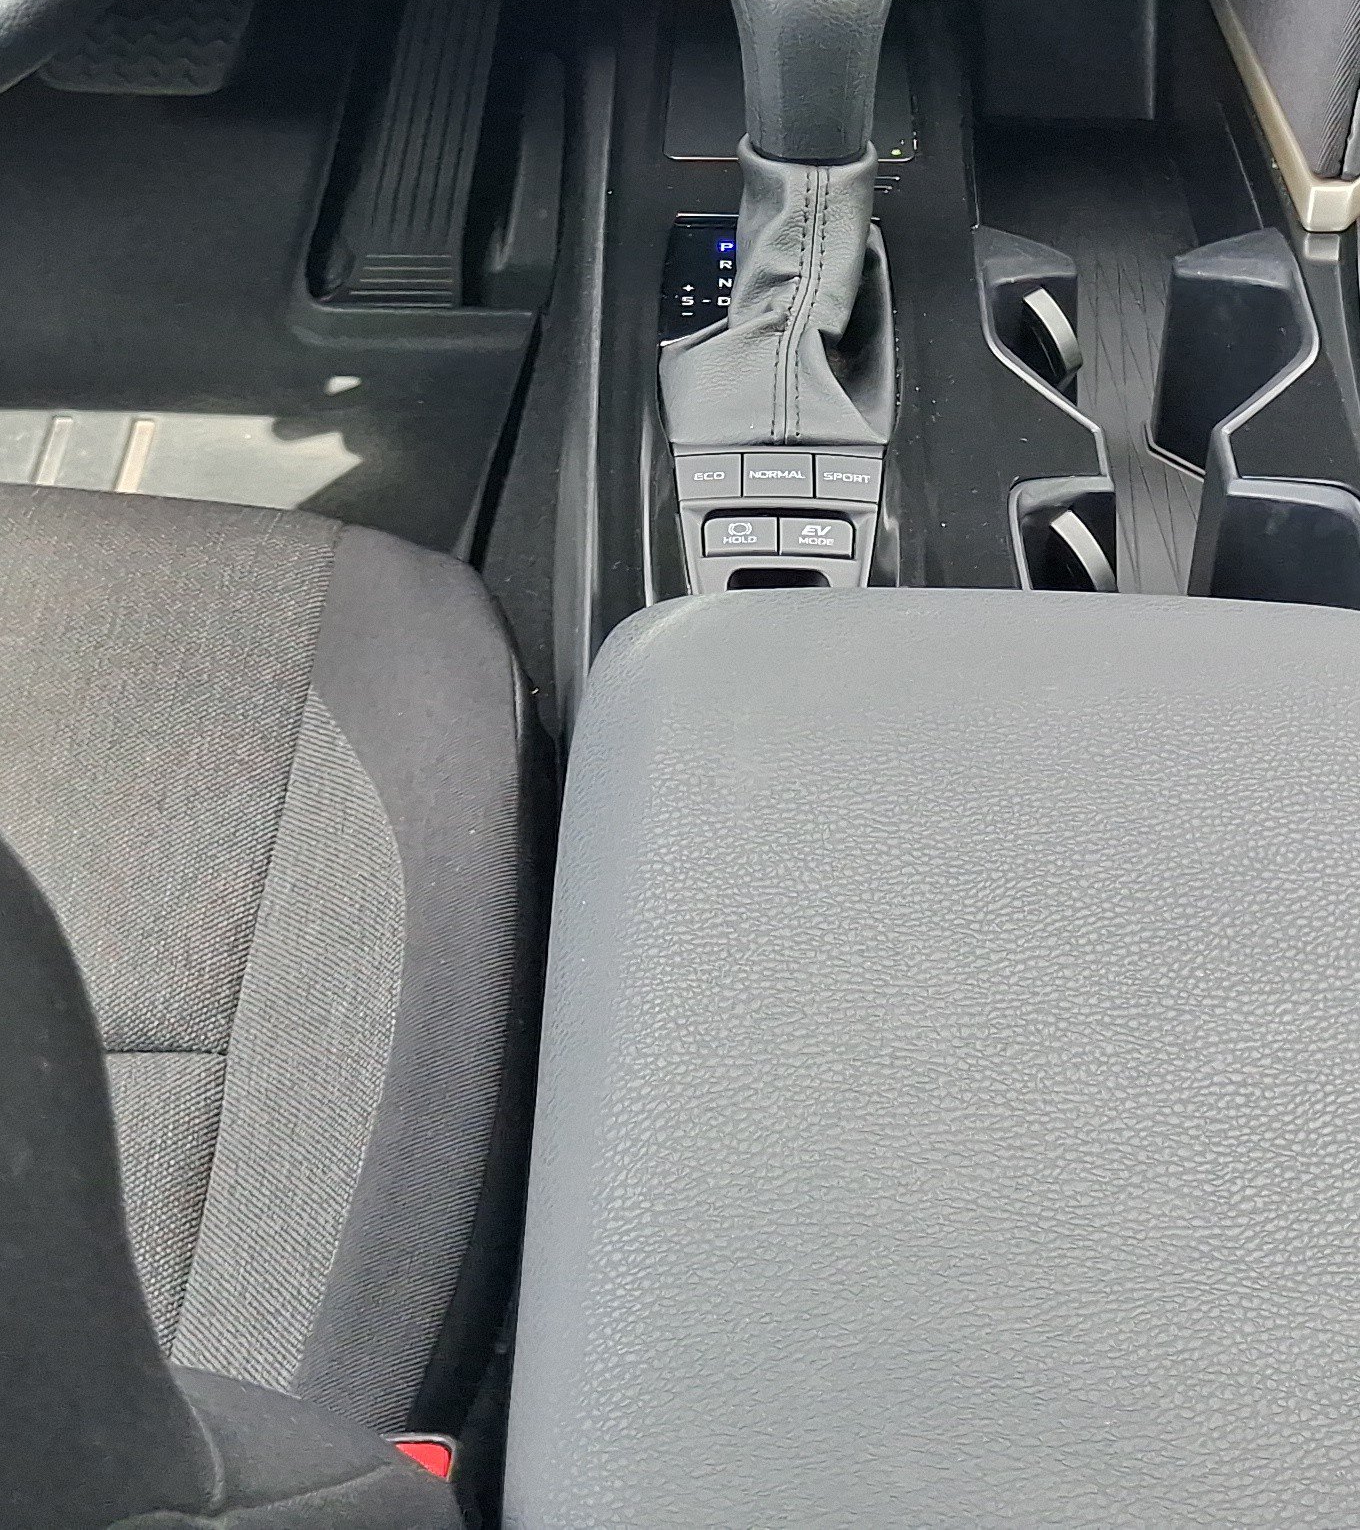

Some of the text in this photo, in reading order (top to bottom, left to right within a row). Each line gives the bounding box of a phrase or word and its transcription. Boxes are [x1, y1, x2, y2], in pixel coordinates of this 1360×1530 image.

[720, 241, 734, 253] P
[719, 259, 733, 270] R
[718, 278, 733, 289] N
[680, 295, 731, 306] S D
[693, 470, 726, 482] ECO
[748, 469, 807, 481] NORMAL
[822, 471, 872, 485] SPORT
[800, 524, 832, 537] EV
[722, 534, 758, 545] HOLD
[798, 536, 835, 547] MODE
